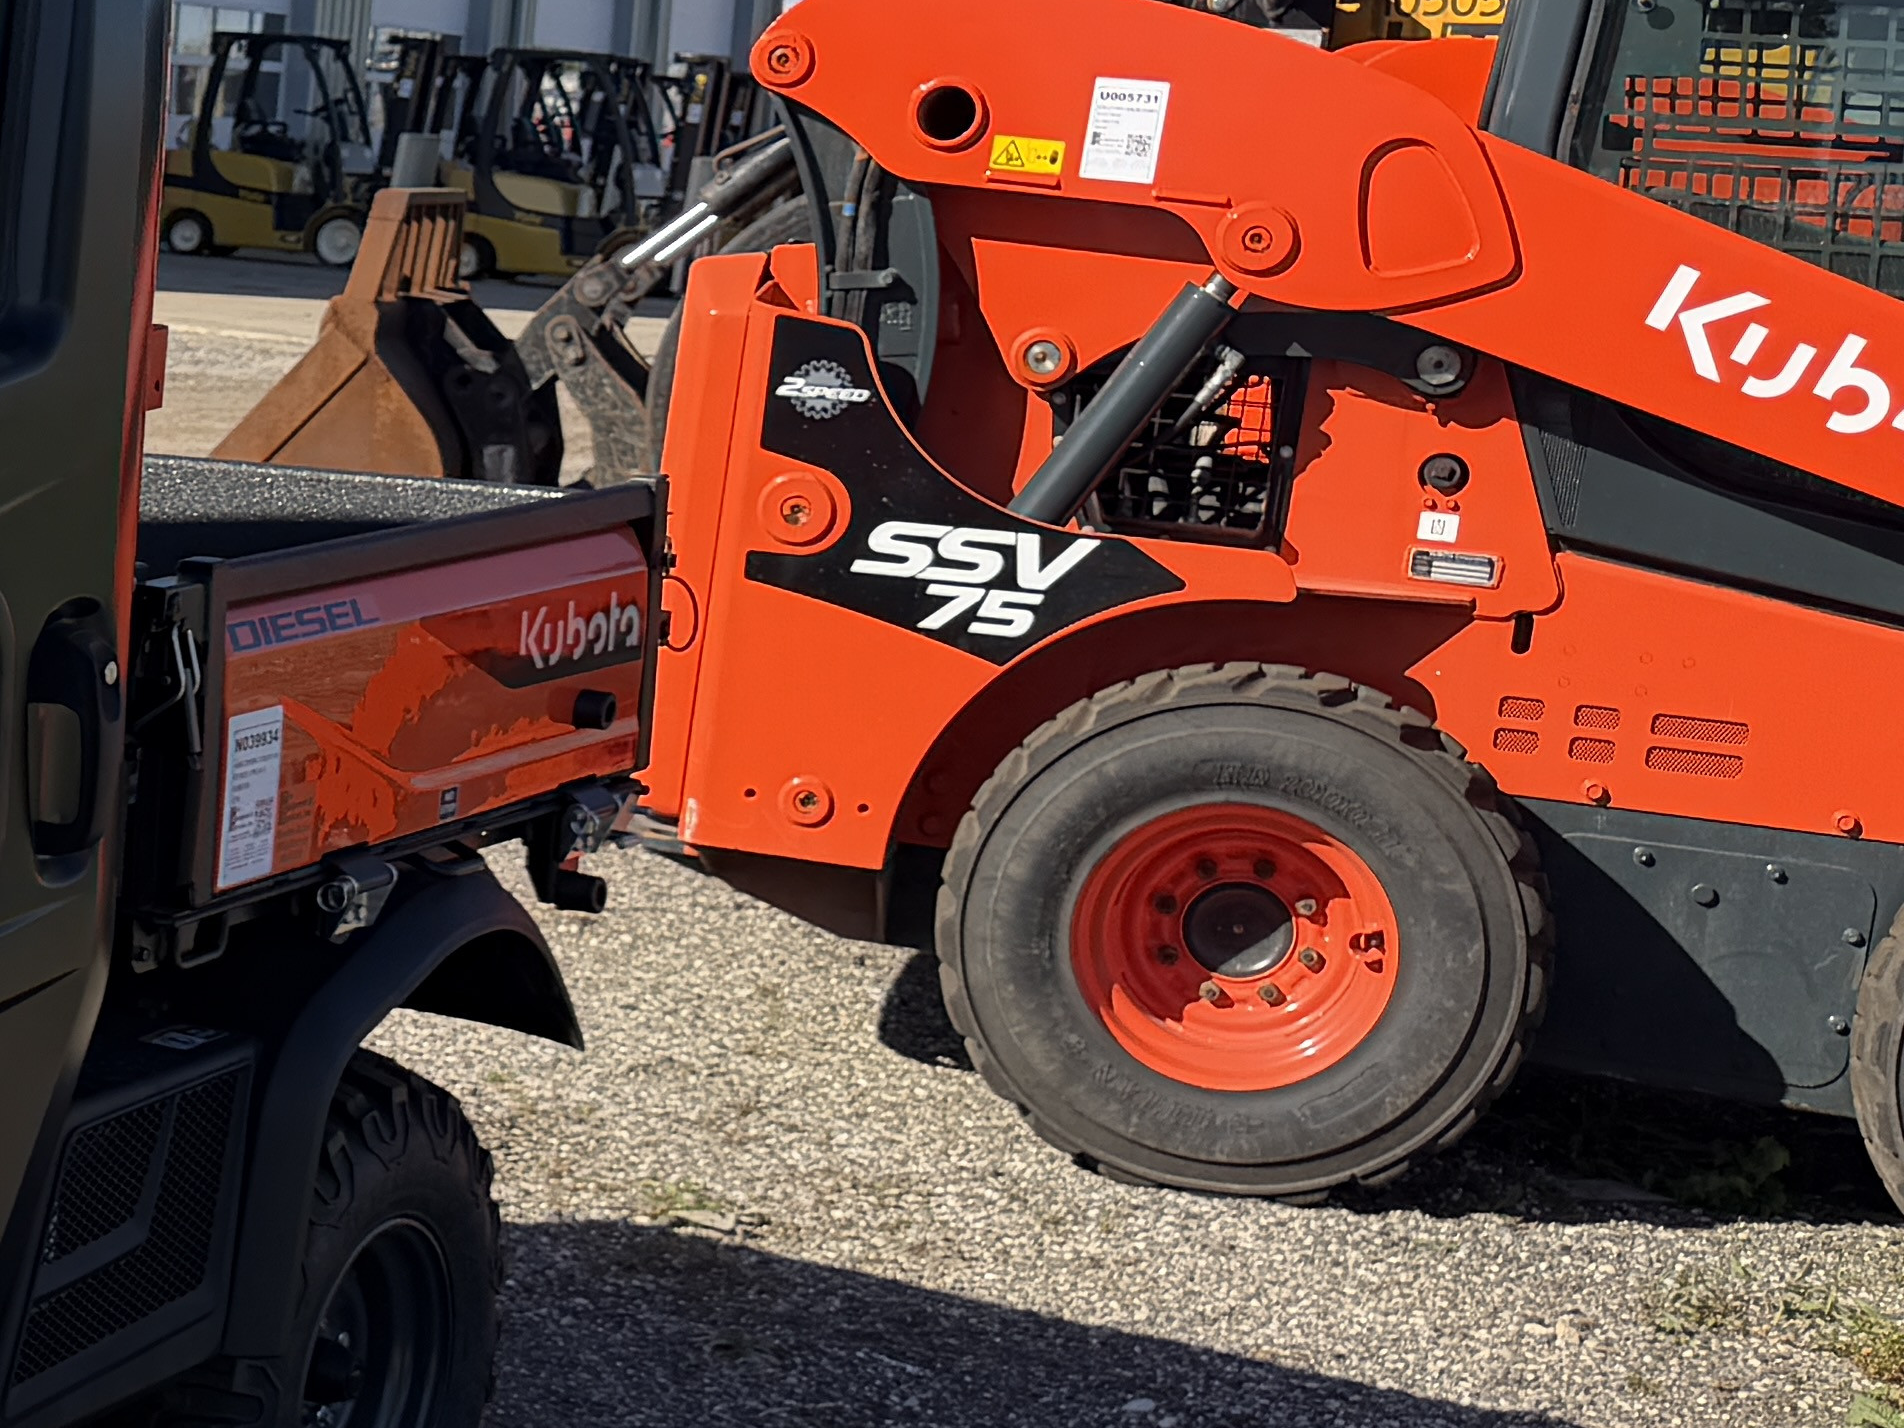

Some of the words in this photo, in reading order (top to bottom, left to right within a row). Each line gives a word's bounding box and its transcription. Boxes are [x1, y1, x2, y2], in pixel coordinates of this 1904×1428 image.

[1099, 91, 1159, 104] U005731
[1645, 264, 1904, 434] Kub
[850, 521, 1102, 590] SSV
[226, 598, 381, 652] DIESEL
[518, 590, 640, 669] Kubota
[916, 583, 1045, 638] 75
